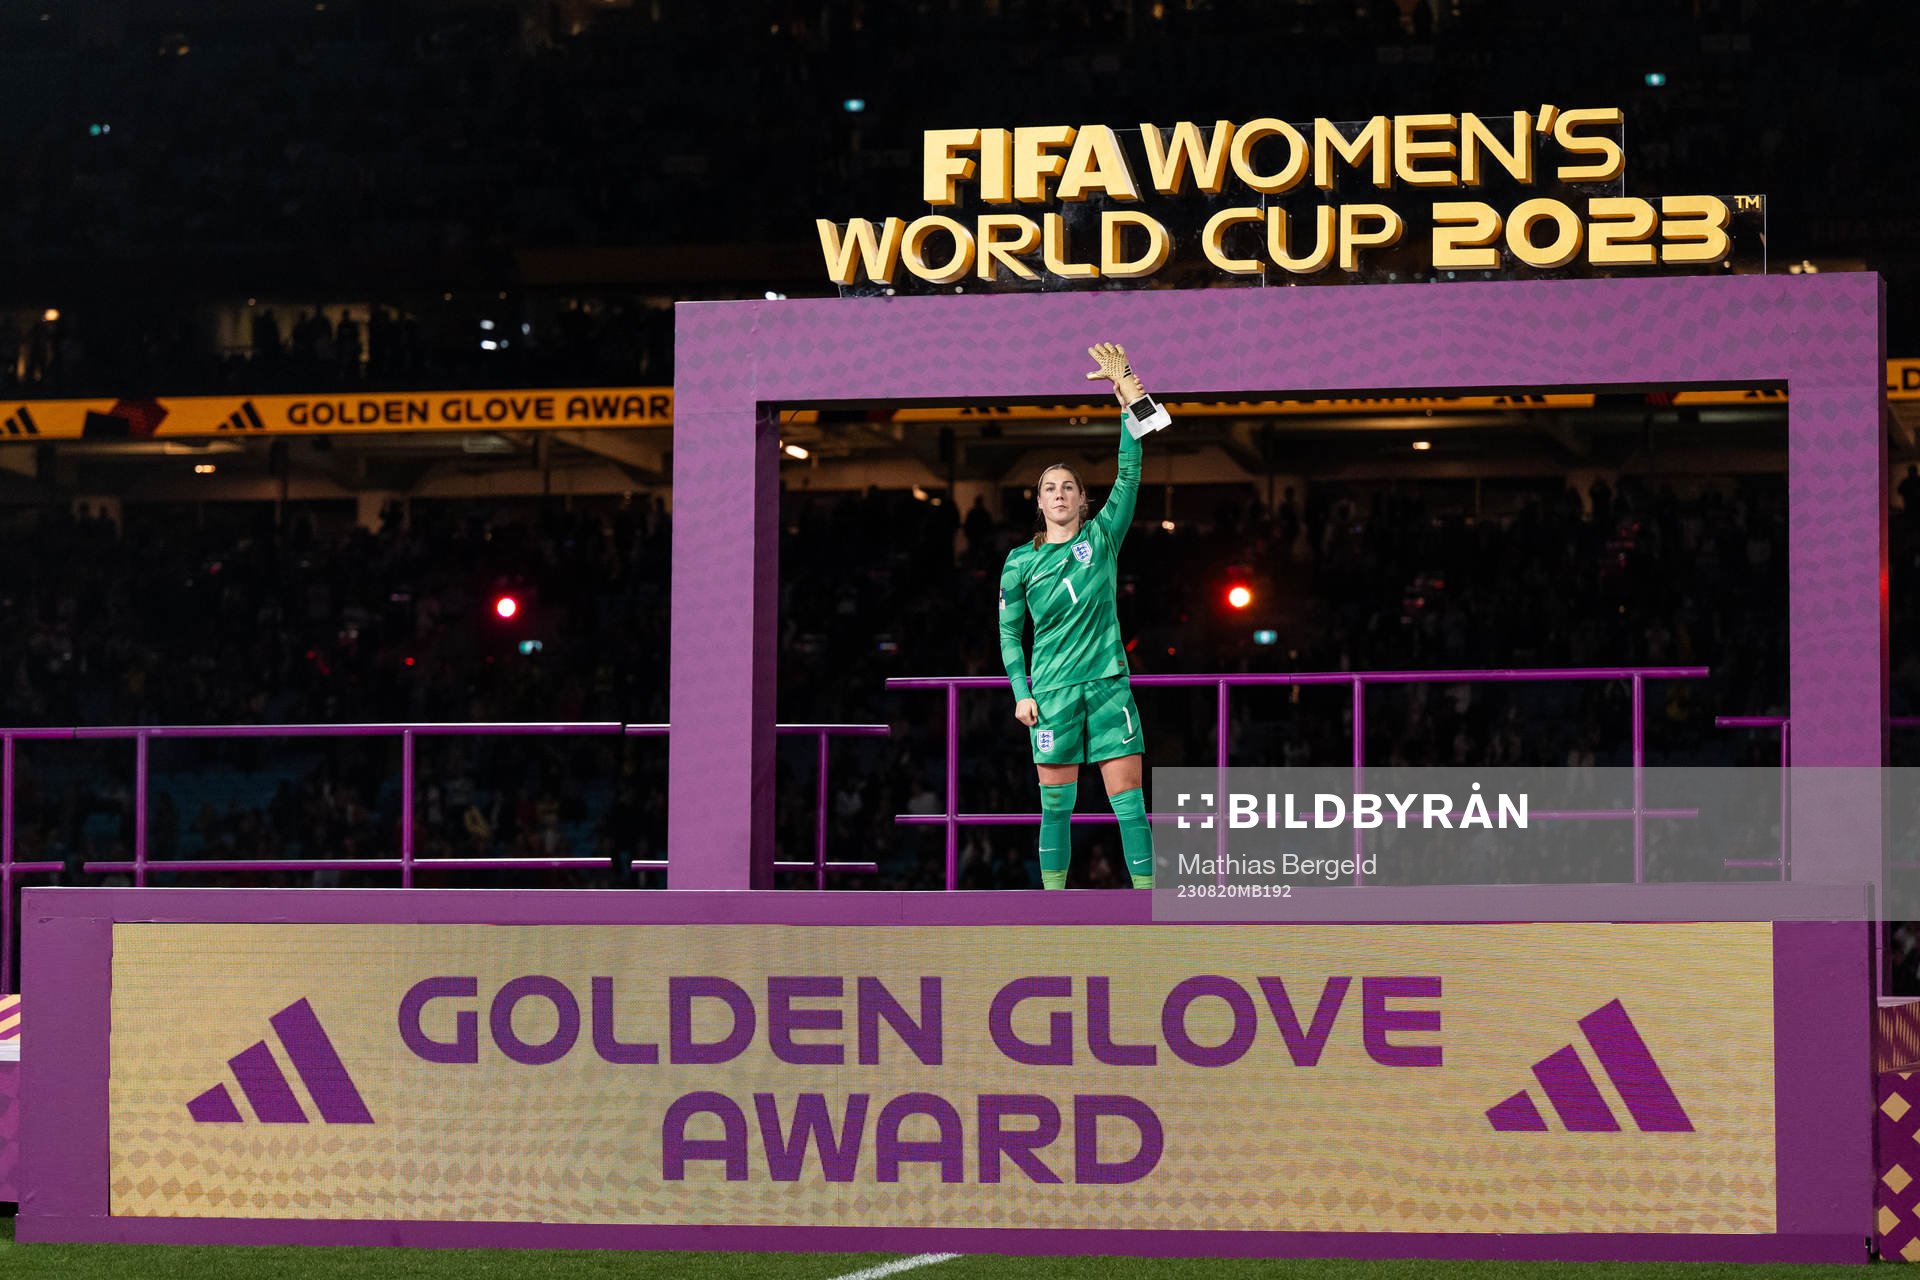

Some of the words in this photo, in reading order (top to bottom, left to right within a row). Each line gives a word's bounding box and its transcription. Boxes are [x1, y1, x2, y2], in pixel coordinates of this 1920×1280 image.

[923, 124, 1143, 206] FIFA
[1140, 103, 1626, 196] WOMEN'S
[815, 209, 1171, 286] WORLD
[1202, 203, 1403, 275] CUP
[1432, 194, 1731, 270] 2023
[287, 400, 429, 425] GOLDEN
[441, 397, 555, 422] GLOVE
[566, 395, 671, 419] AWAR
[1062, 577, 1079, 605] 1
[1122, 706, 1133, 735] 1
[398, 974, 943, 1066] GOLDEN
[988, 974, 1444, 1068] GLOVE
[661, 1090, 1164, 1185] AWARD
